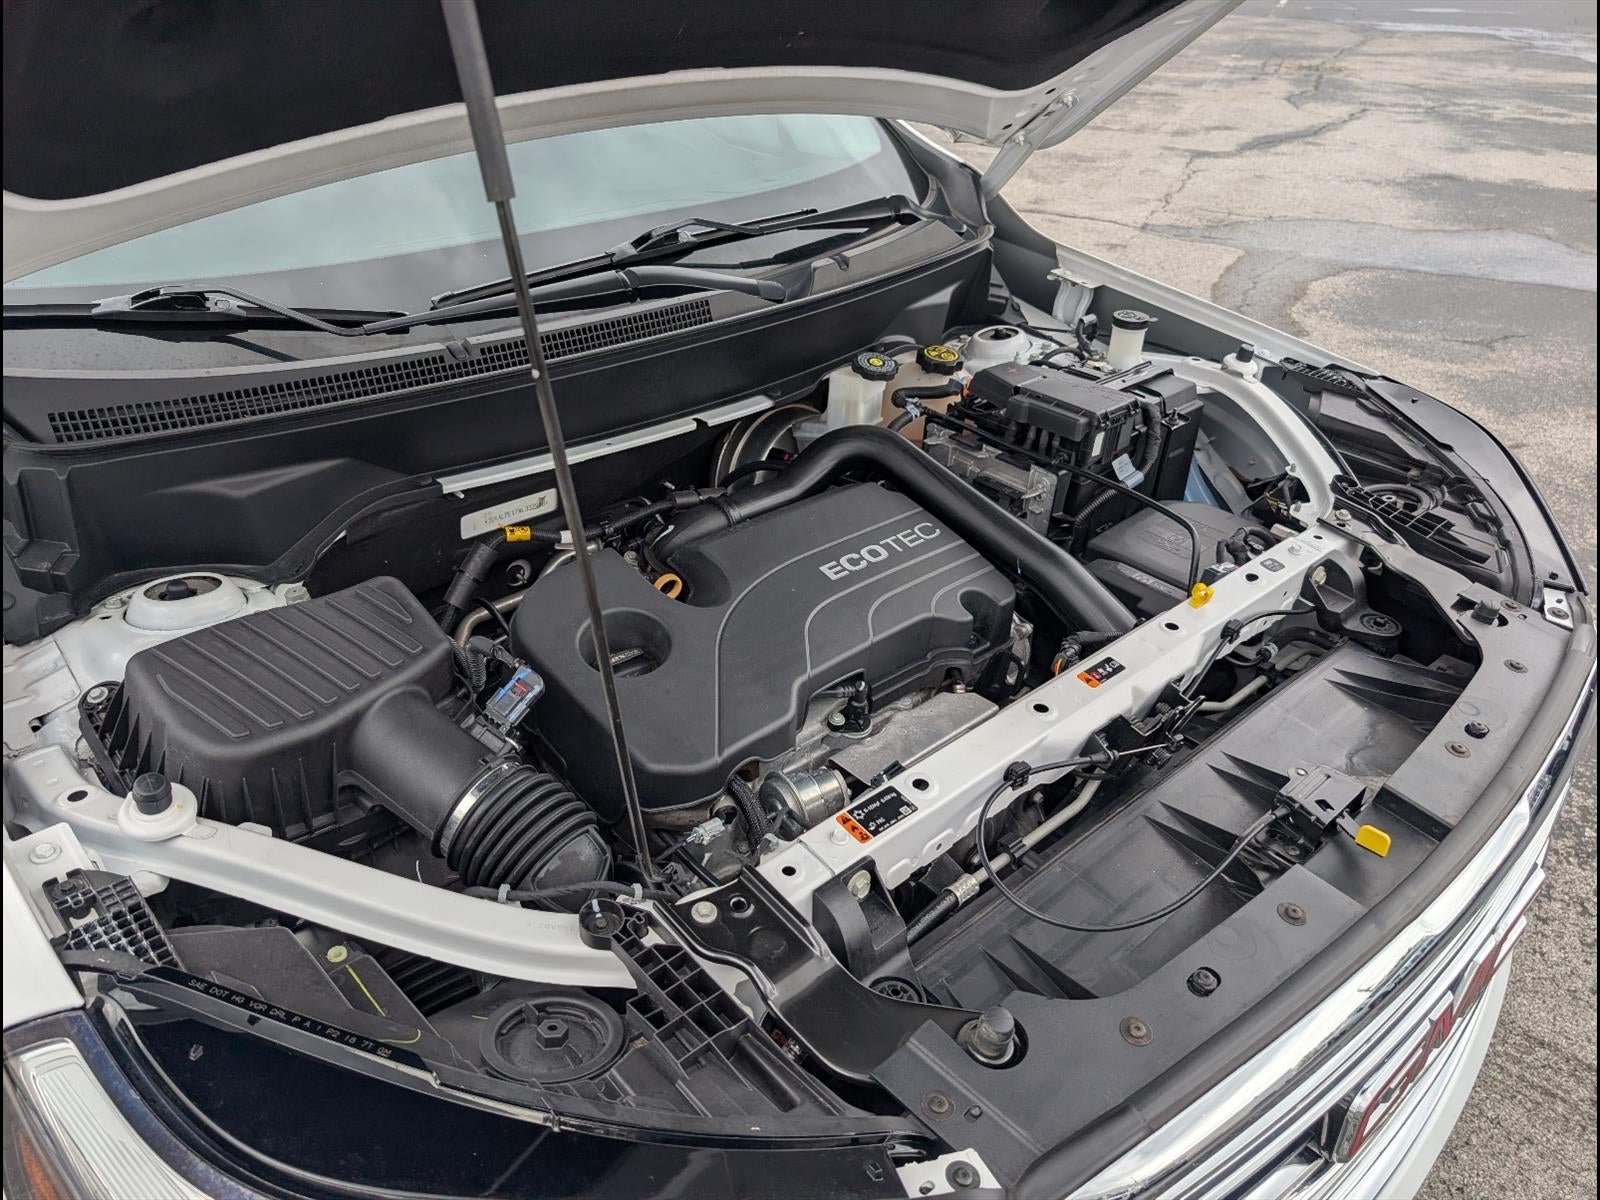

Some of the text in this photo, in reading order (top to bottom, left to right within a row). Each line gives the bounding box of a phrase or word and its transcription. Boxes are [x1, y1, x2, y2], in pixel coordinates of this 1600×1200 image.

[819, 522, 941, 580] ECOTEC
[188, 979, 207, 990] SAE
[209, 987, 229, 997] DOT
[249, 1001, 267, 1011] VOR
[269, 1008, 286, 1019] DRL
[1338, 870, 1544, 1162] GMC
